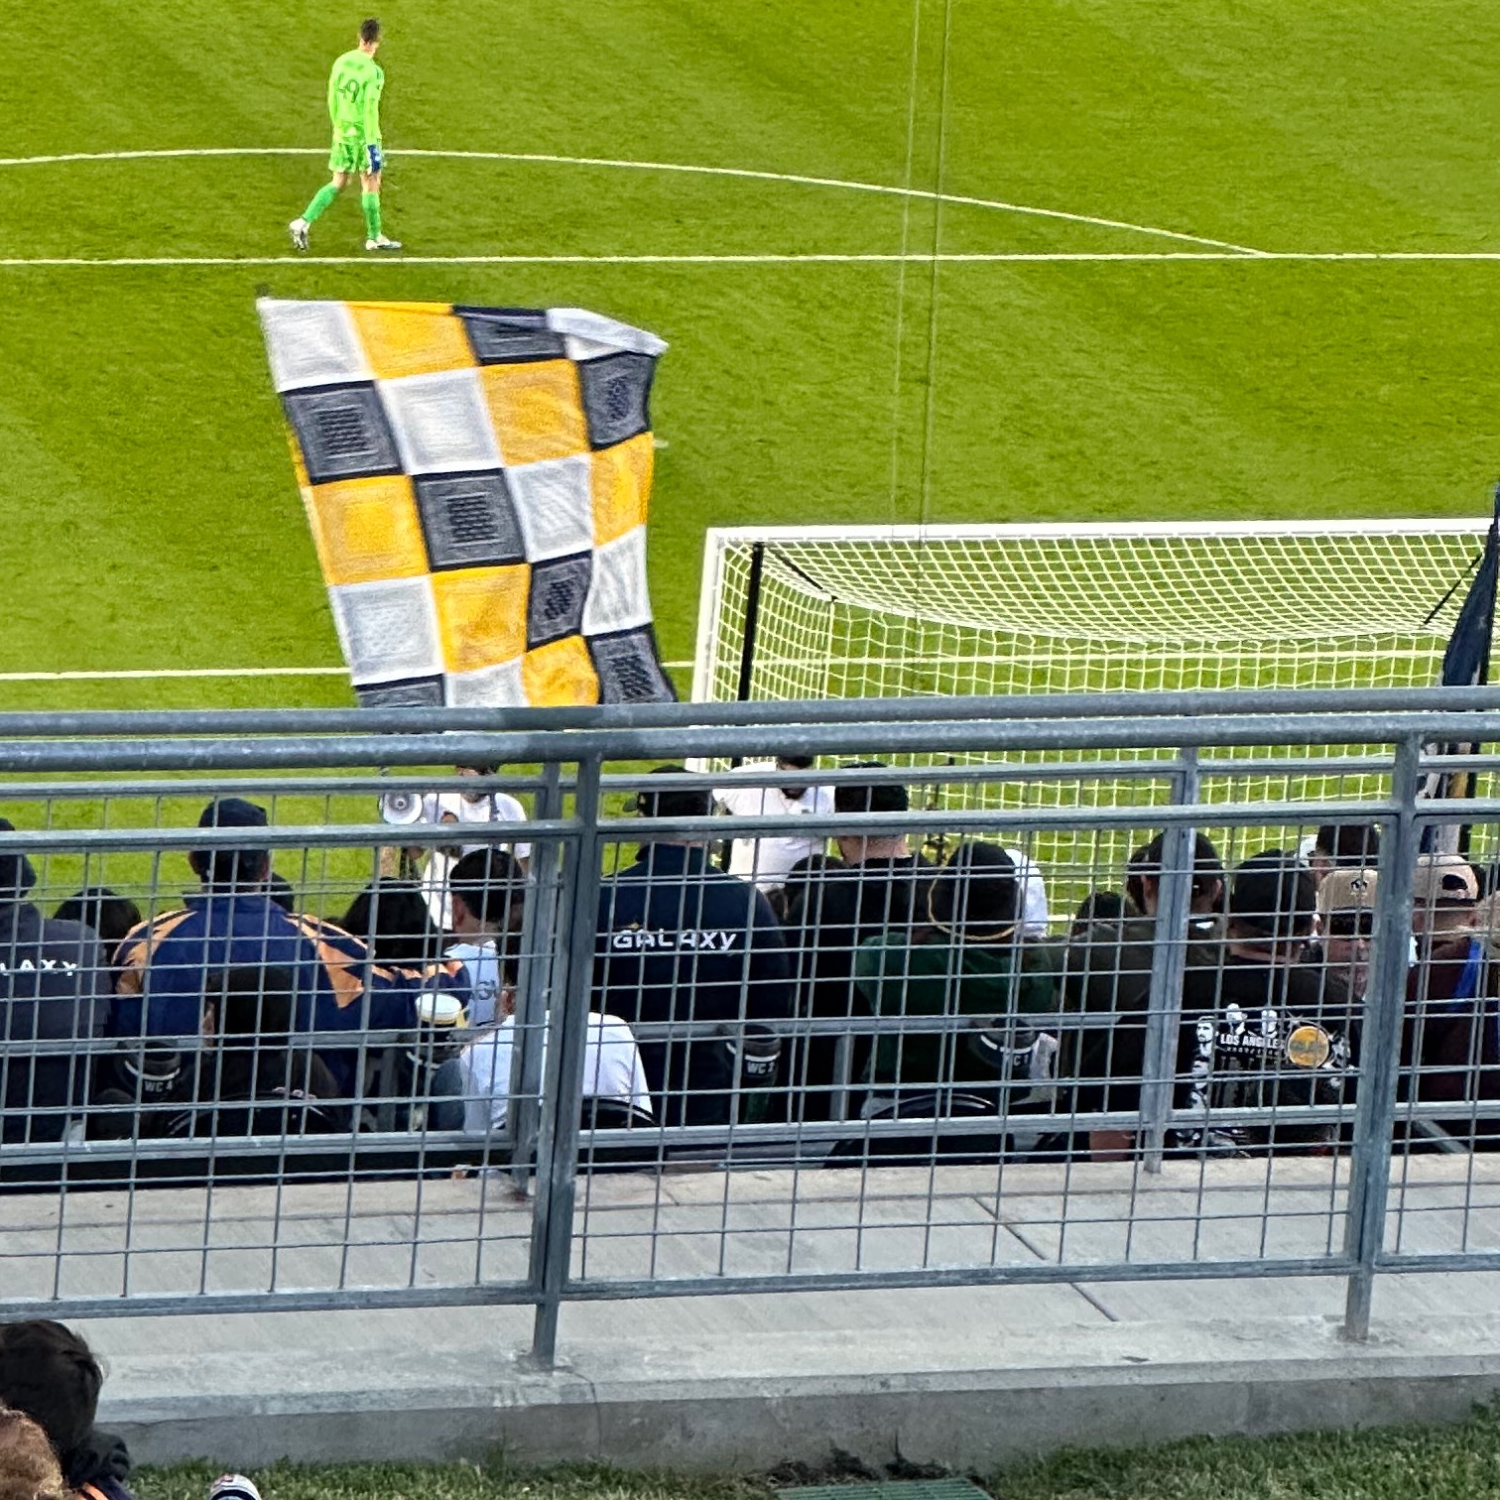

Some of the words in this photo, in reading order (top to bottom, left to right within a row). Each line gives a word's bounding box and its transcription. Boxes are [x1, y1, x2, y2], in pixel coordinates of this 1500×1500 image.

[613, 928, 737, 952] GALAXY
[1220, 1034, 1240, 1045] LOS
[1242, 1036, 1285, 1049] ANGLE
[747, 1062, 766, 1074] WC
[144, 1081, 163, 1093] WC
